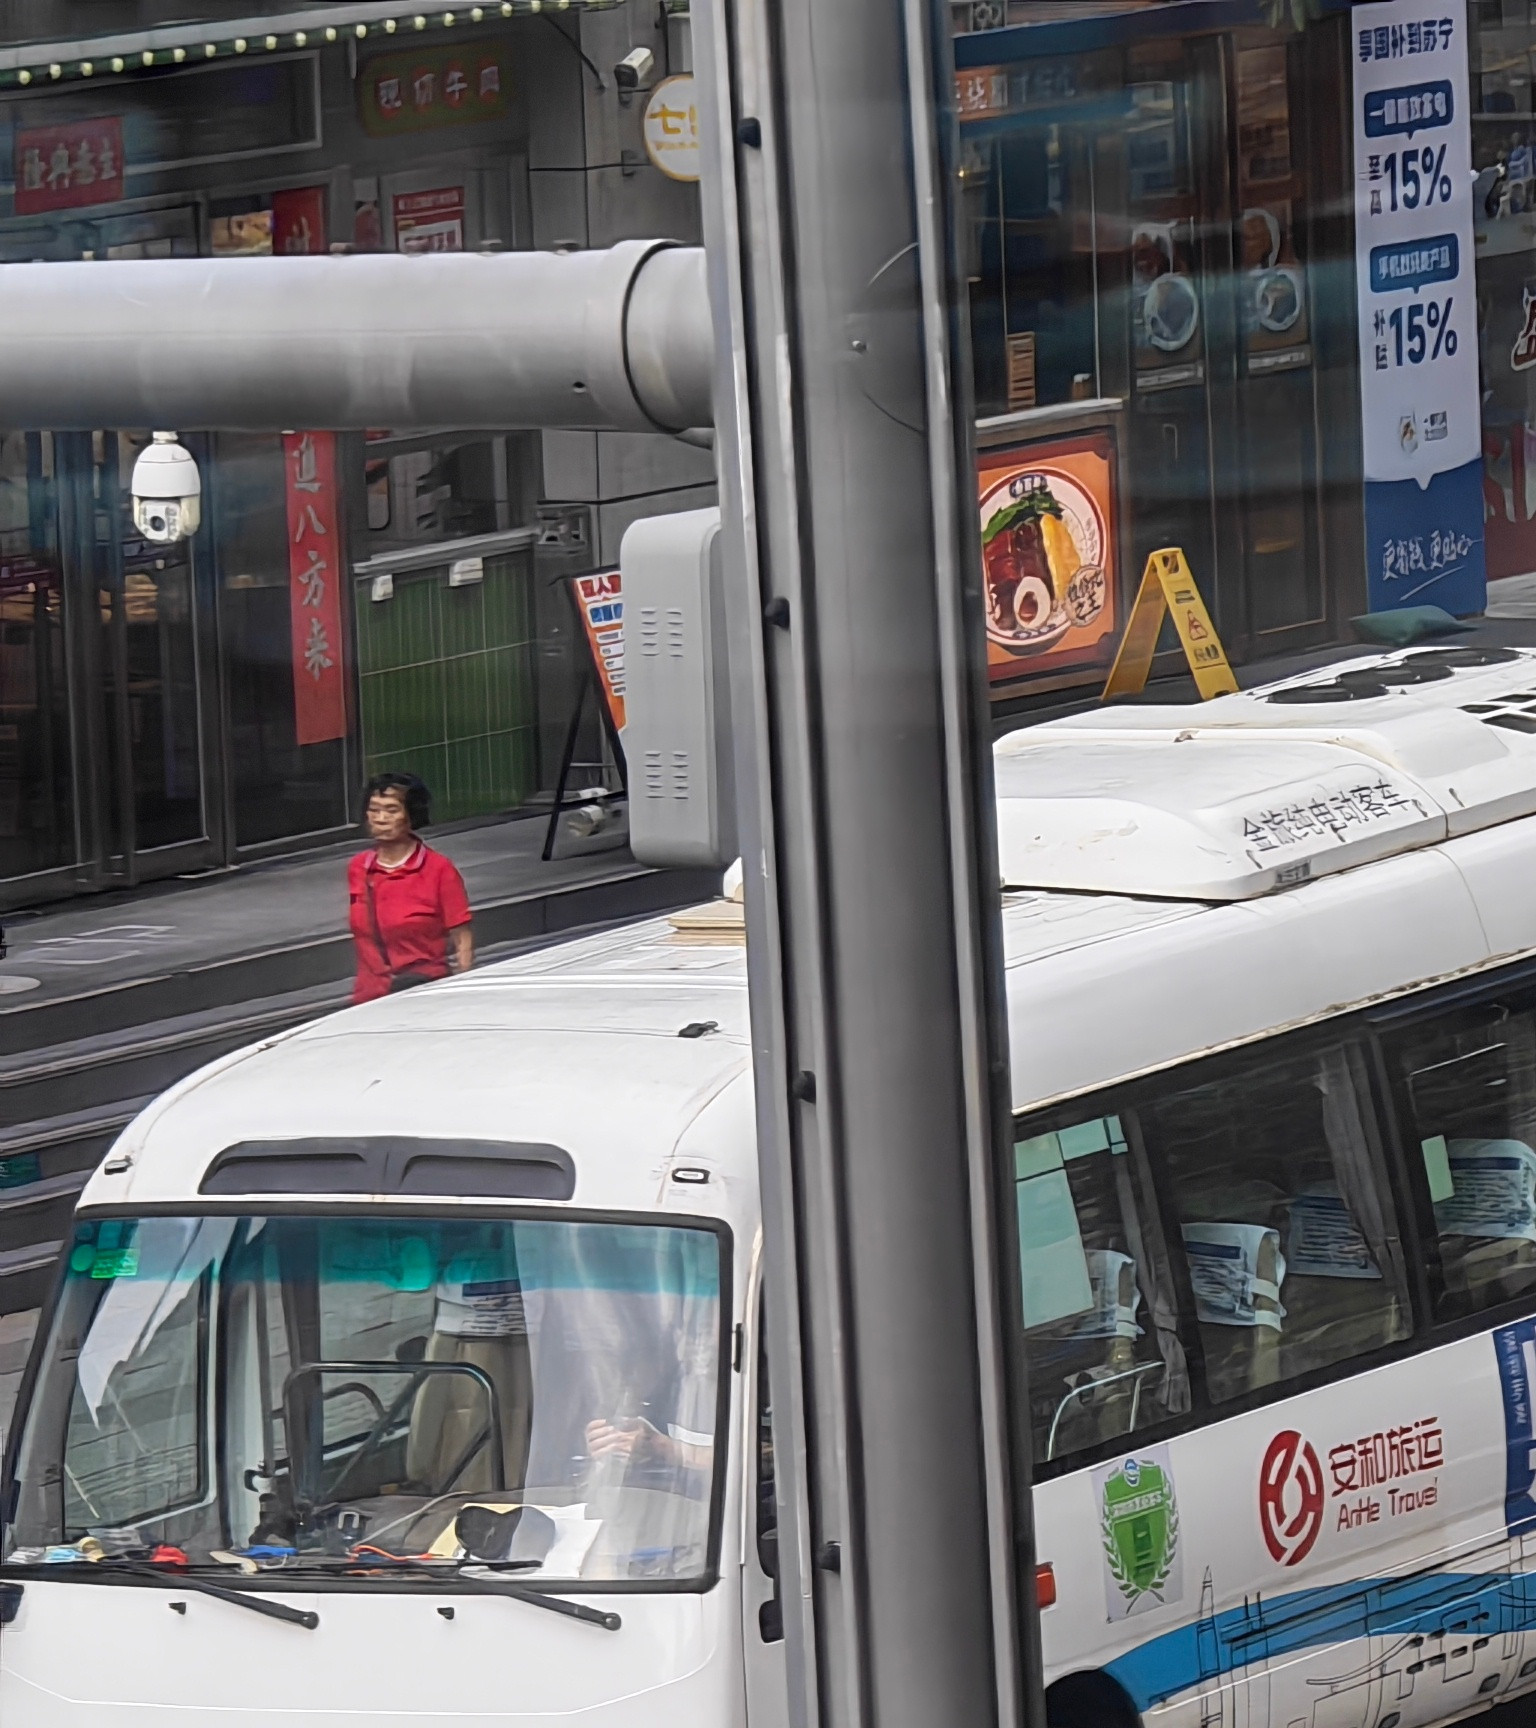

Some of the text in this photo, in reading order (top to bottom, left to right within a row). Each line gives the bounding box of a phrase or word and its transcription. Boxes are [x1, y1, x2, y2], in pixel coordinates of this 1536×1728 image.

[1384, 144, 1452, 213] 15%
[1389, 297, 1458, 367] 15%
[1329, 1416, 1444, 1497] 安和旅运
[1337, 1477, 1439, 1532] AnHe Travel
